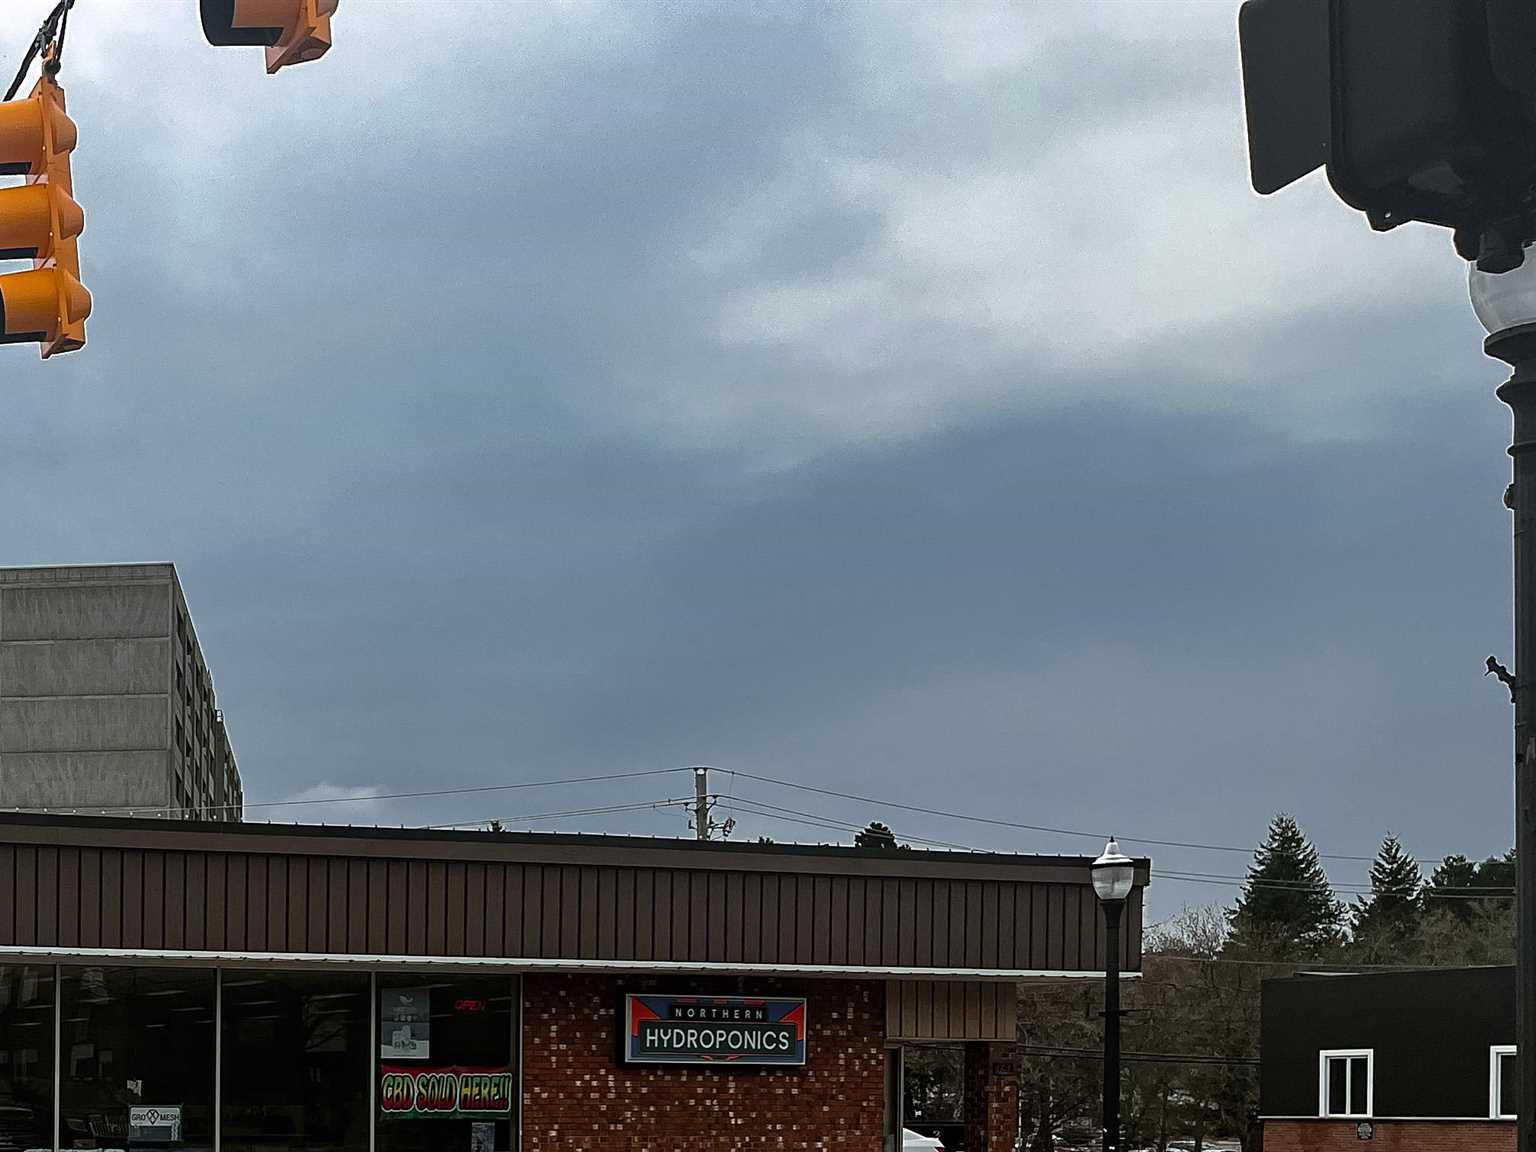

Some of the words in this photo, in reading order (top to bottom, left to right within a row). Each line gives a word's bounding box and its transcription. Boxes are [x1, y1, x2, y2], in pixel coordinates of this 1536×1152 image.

[675, 1008, 763, 1019] NORTHERN
[646, 1028, 790, 1050] HYDROPONICS
[383, 1074, 414, 1111] CBD
[417, 1074, 457, 1111] SOLD
[460, 1074, 511, 1111] HERE!!
